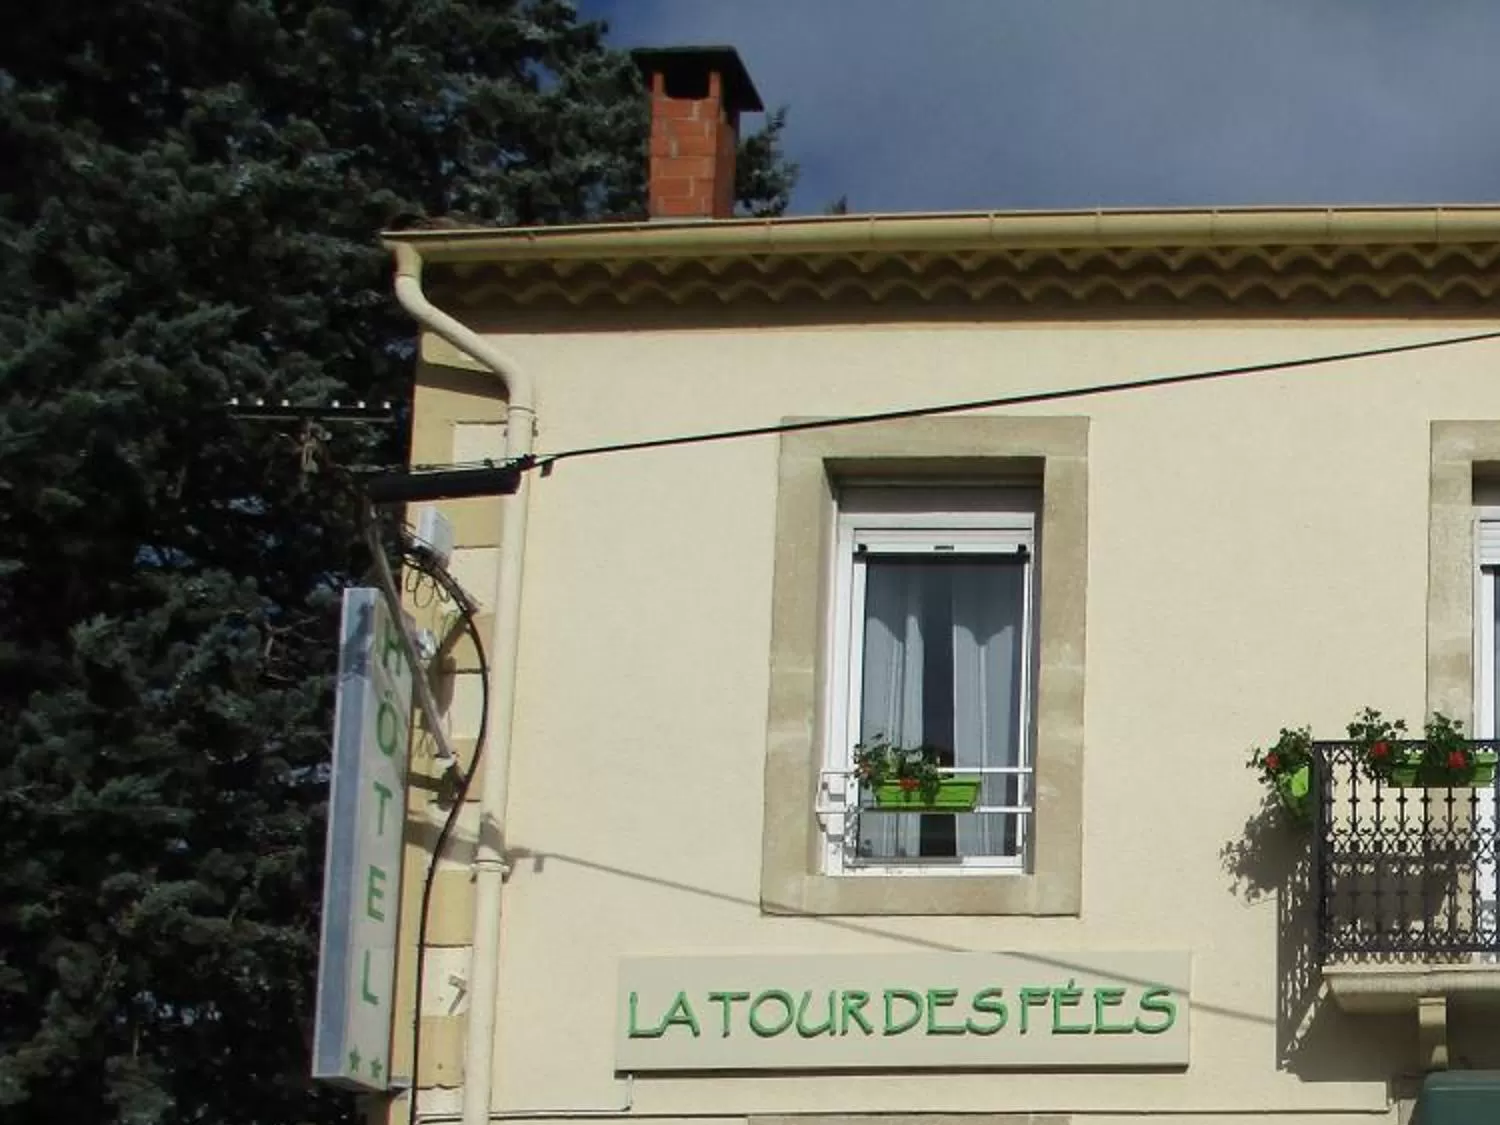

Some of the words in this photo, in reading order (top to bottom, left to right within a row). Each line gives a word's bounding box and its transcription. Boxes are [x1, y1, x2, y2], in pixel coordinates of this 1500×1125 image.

[628, 990, 701, 1038] LA
[707, 989, 874, 1038] TOUR
[882, 988, 1009, 1036] DES
[1018, 978, 1179, 1035] FÉES
